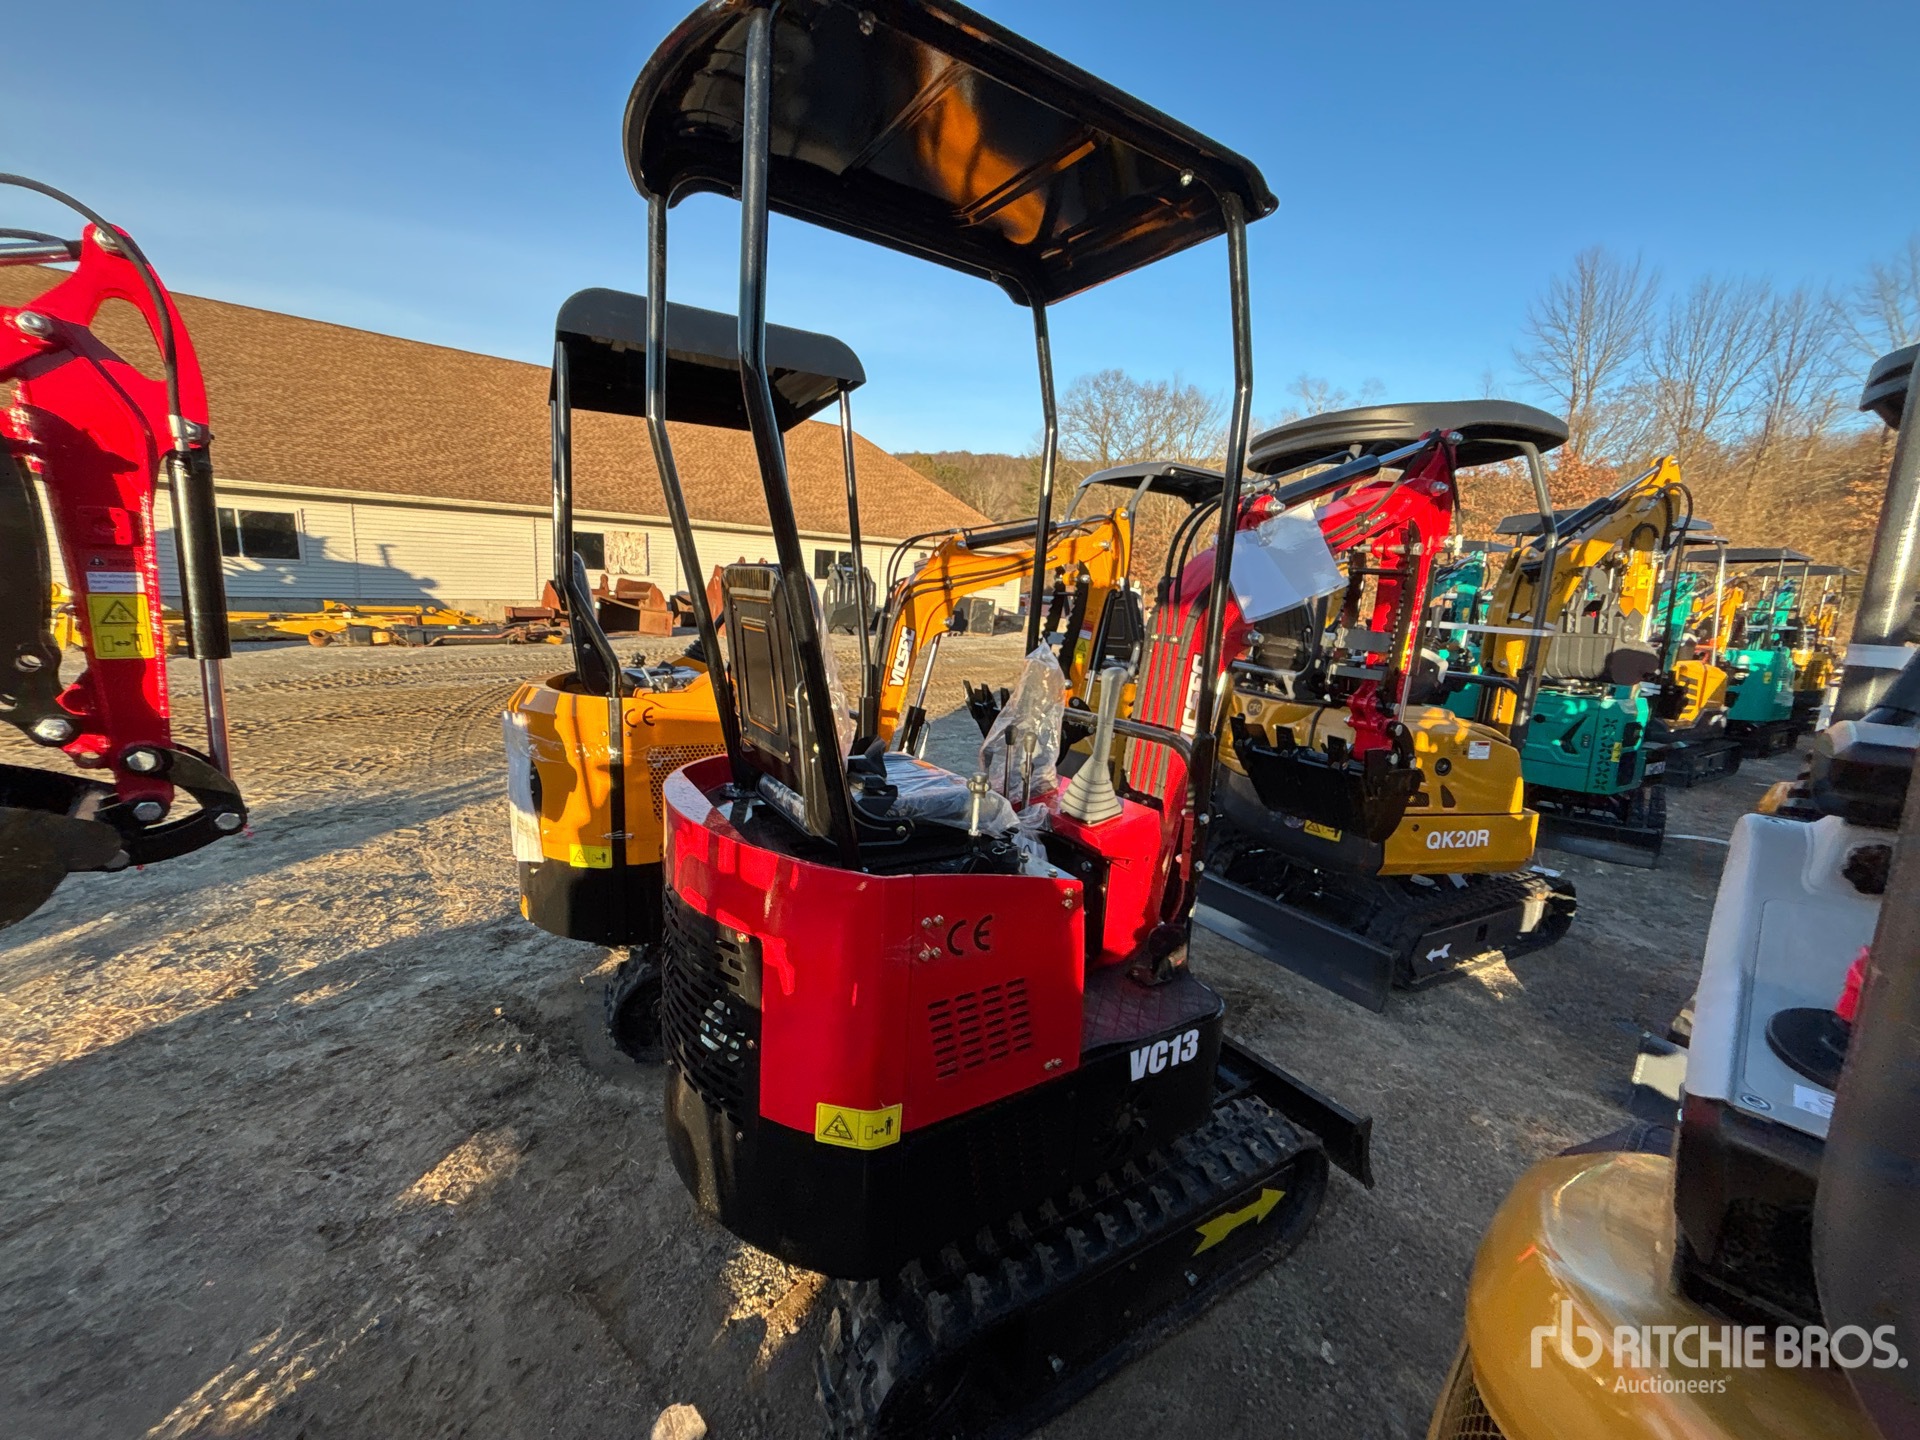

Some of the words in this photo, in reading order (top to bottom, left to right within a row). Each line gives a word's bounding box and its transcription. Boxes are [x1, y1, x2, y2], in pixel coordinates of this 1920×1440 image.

[888, 625, 916, 687] VICSEC
[624, 706, 655, 728] CE
[1180, 653, 1204, 746] ICSEC
[1426, 829, 1490, 850] QK20R
[946, 914, 993, 956] CE
[1130, 1028, 1199, 1082] VC13
